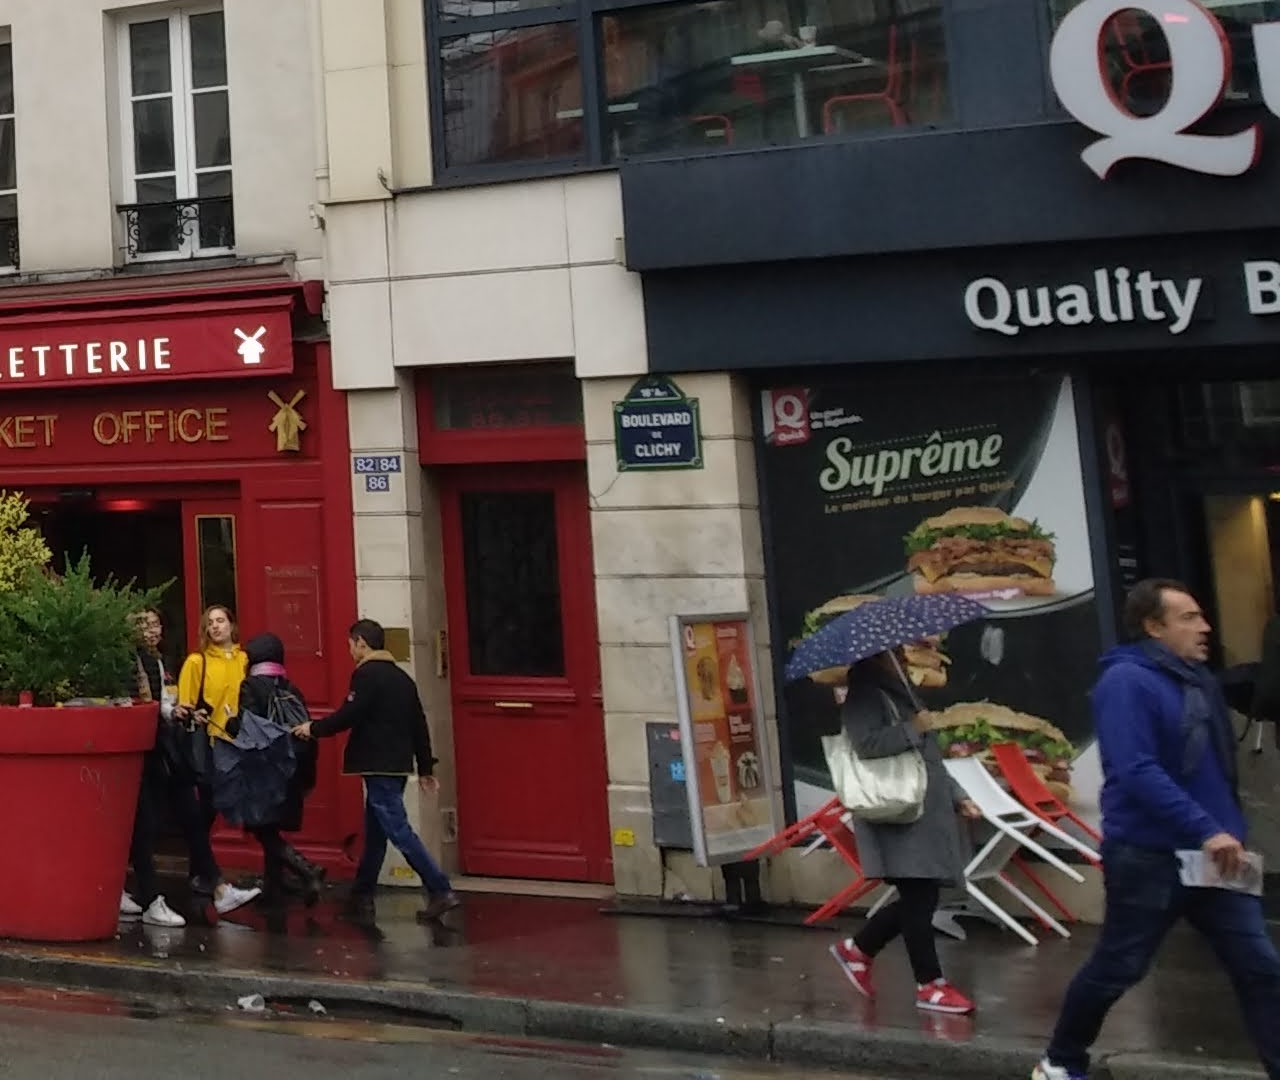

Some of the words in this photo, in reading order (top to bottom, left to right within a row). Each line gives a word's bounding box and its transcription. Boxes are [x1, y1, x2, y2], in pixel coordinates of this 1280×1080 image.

[964, 266, 1202, 335] Quality
[93, 407, 230, 446] OFFICE
[621, 412, 691, 428] BOULEVARD
[635, 443, 681, 458] CLICHY
[356, 458, 374, 472] 82
[380, 458, 398, 471] 84
[819, 430, 1003, 497] Suprême
[368, 476, 387, 490] 86
